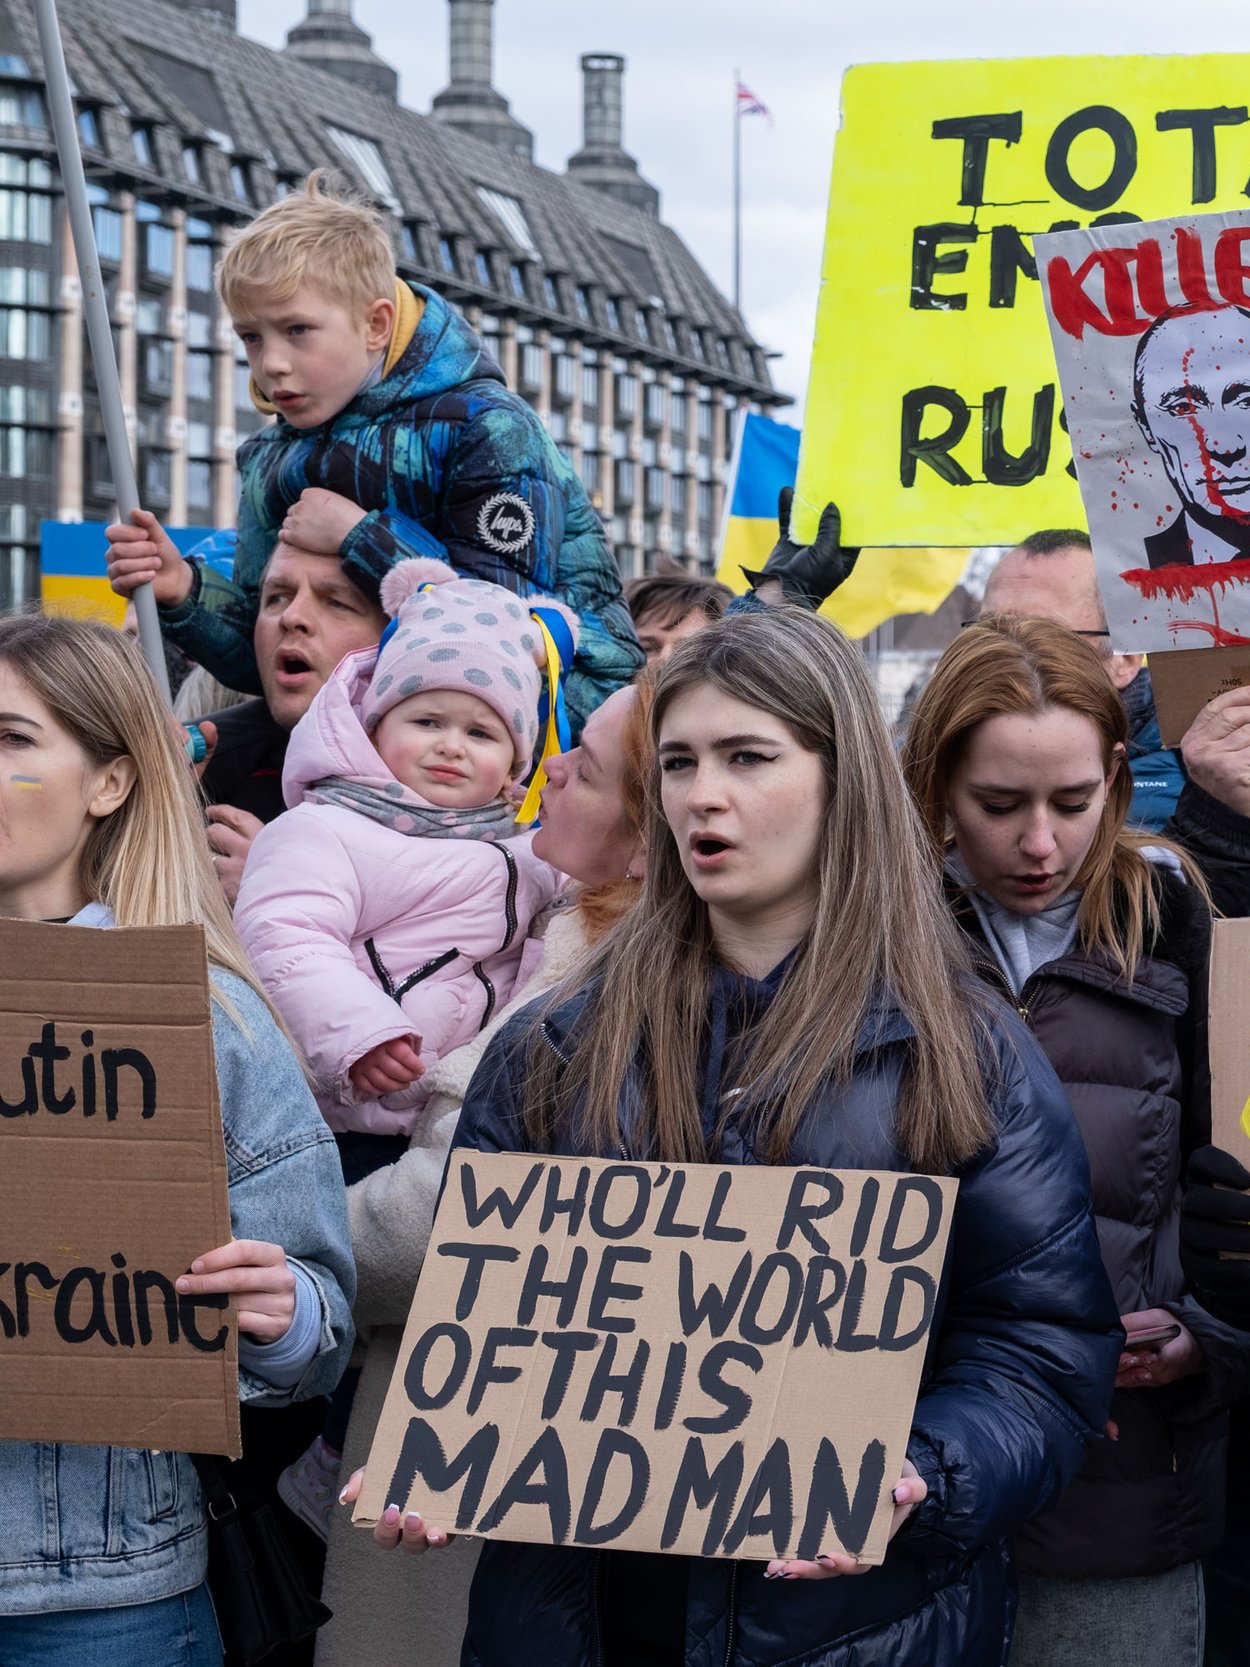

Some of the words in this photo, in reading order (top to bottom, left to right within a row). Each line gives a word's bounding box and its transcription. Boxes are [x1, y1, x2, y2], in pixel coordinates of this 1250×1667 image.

[460, 1161, 747, 1243] WHO'LL
[776, 1170, 945, 1264] RID
[436, 1242, 652, 1334] THE
[677, 1248, 938, 1353] WORLD
